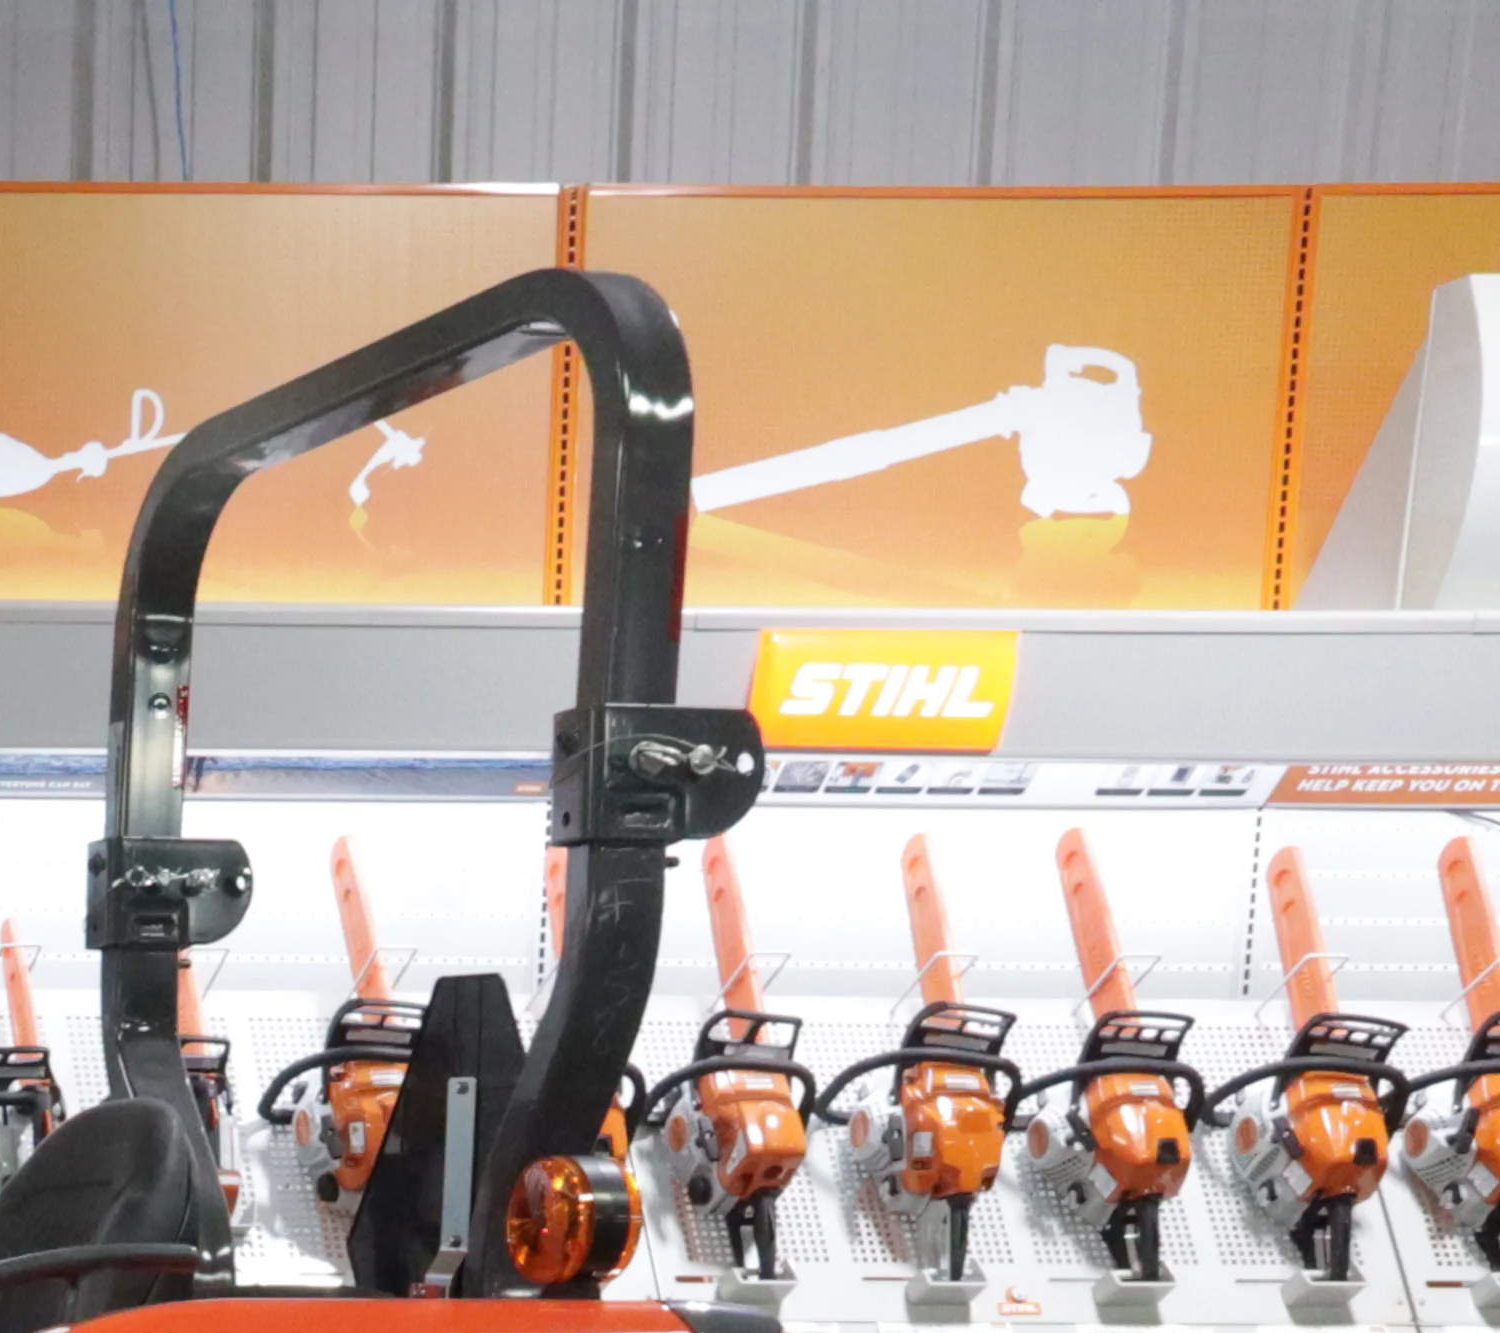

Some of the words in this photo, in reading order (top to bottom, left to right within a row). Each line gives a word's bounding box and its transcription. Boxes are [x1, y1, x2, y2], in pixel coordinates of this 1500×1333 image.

[779, 662, 994, 718] STIHL
[1296, 778, 1349, 792] HELP
[1351, 778, 1405, 792] KEEP
[1409, 778, 1452, 792] YOU
[1453, 779, 1486, 792] ON
